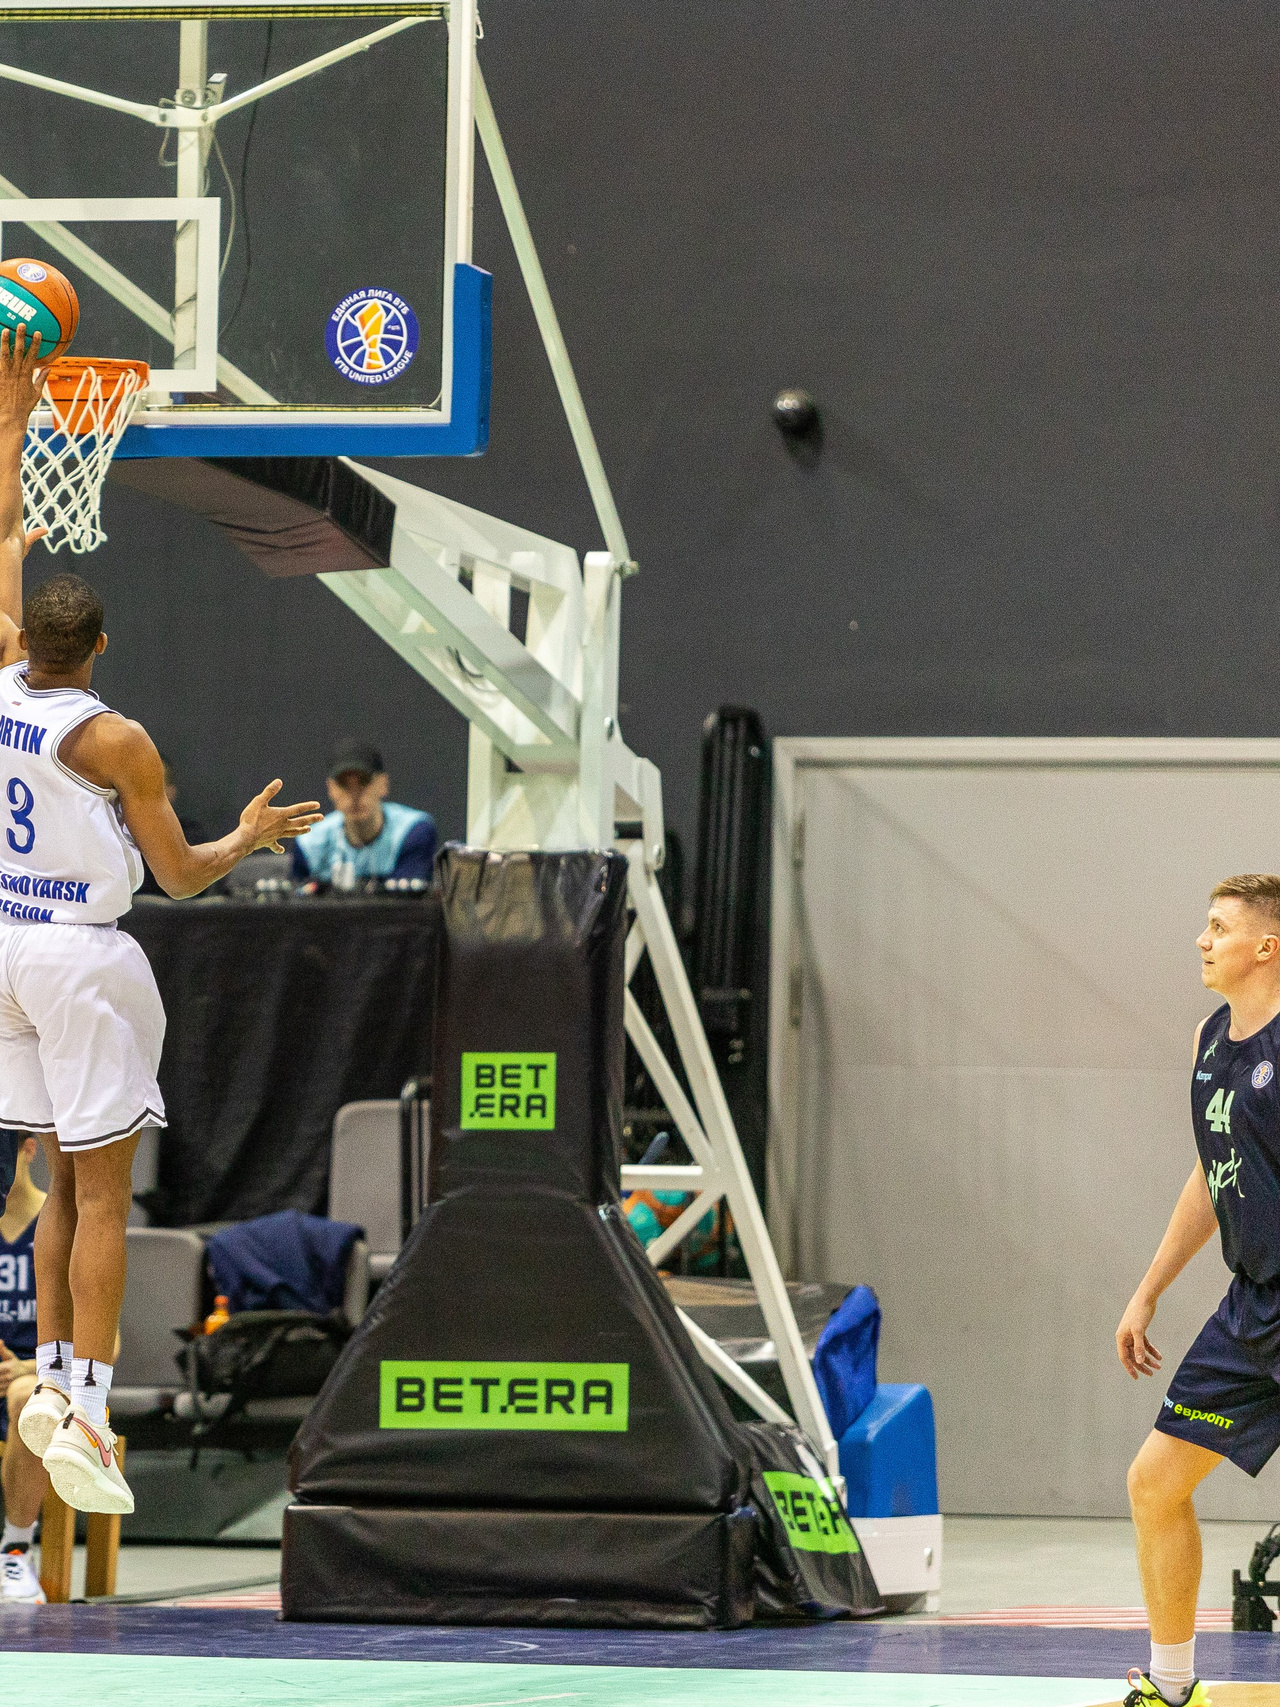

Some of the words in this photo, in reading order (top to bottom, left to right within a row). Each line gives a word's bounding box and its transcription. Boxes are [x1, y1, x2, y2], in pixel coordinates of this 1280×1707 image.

[331, 290, 366, 322] ЕДИНАЯ
[367, 289, 393, 301] ЛИГА
[392, 297, 410, 315] ВТБ
[334, 356, 350, 374] VTB
[348, 370, 382, 383] UNITED
[382, 350, 413, 380] LEAGUE
[6, 777, 35, 854] 3
[475, 1064, 548, 1088] BET
